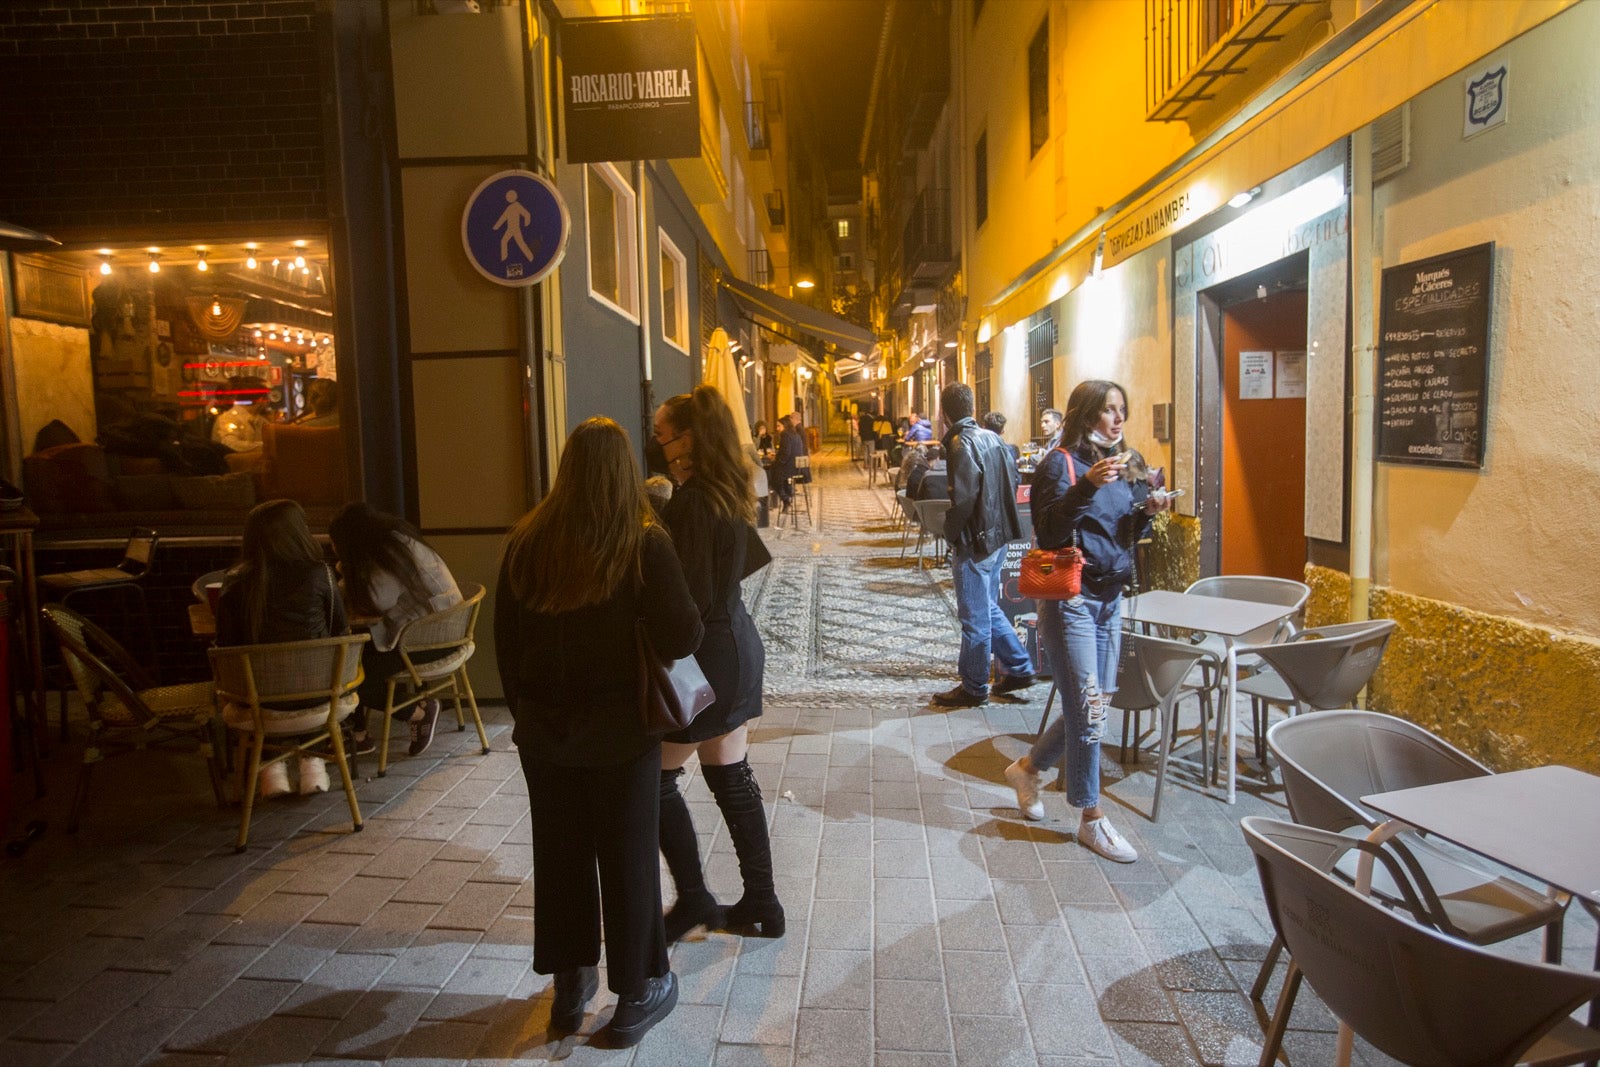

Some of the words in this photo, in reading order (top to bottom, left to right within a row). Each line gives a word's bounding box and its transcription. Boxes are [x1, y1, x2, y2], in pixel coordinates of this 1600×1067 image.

[570, 73, 632, 103] ROSARIO
[636, 69, 691, 99] VARELA
[1416, 268, 1450, 284] Marqués
[1412, 286, 1421, 294] de
[1421, 279, 1453, 293] Cáceres
[1395, 282, 1480, 311] ESPECIALIDADES
[1408, 444, 1443, 455] excellens
